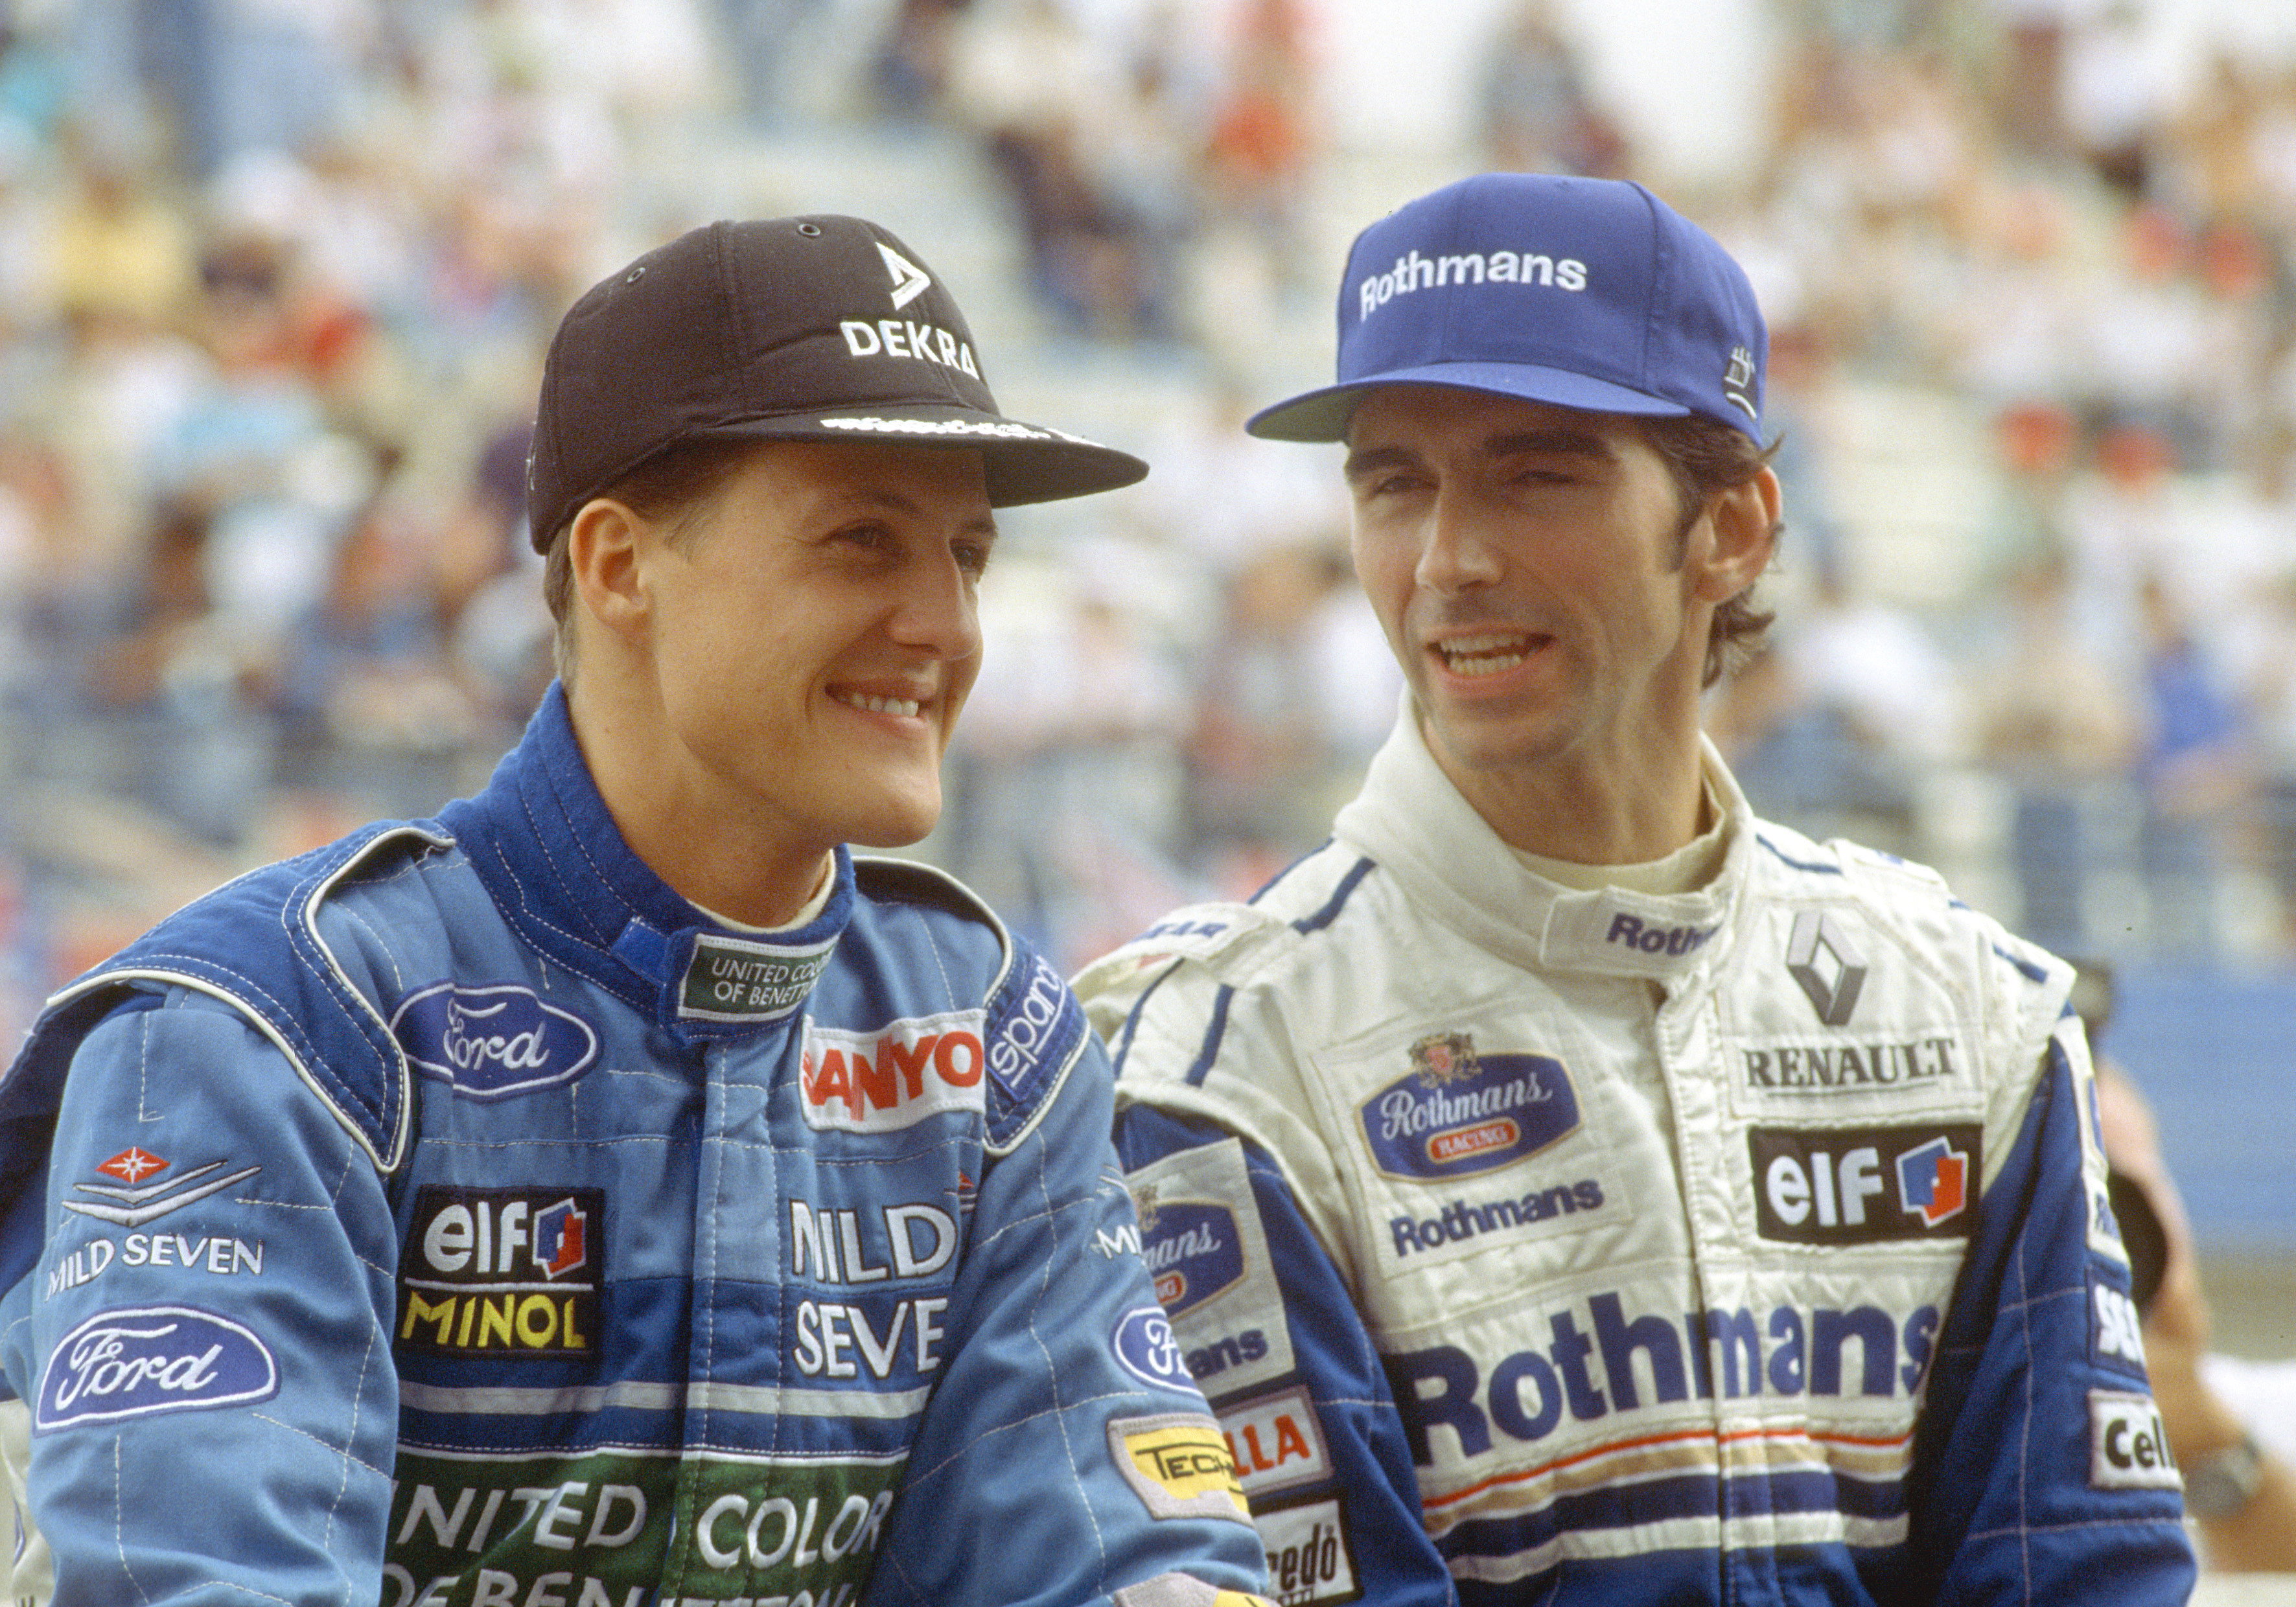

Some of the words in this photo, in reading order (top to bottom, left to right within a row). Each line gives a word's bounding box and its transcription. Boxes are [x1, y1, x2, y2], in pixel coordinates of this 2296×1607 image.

[1361, 250, 1587, 322] Rothmans
[840, 320, 980, 380] DEKRA
[712, 957, 789, 984] UNITED
[714, 980, 746, 1004] OF
[443, 997, 550, 1070] Ford
[1743, 1038, 1956, 1087] RENAULT
[1380, 1072, 1553, 1140] Rothmans
[1390, 1179, 1605, 1257] Rothmans
[1767, 1147, 1884, 1226] elf
[45, 1237, 115, 1302] MILD
[121, 1232, 265, 1275] SEVEN
[424, 1201, 528, 1273] elf
[400, 1291, 586, 1348] MINOL
[55, 1323, 224, 1411] Ford
[388, 1479, 647, 1553] NITED
